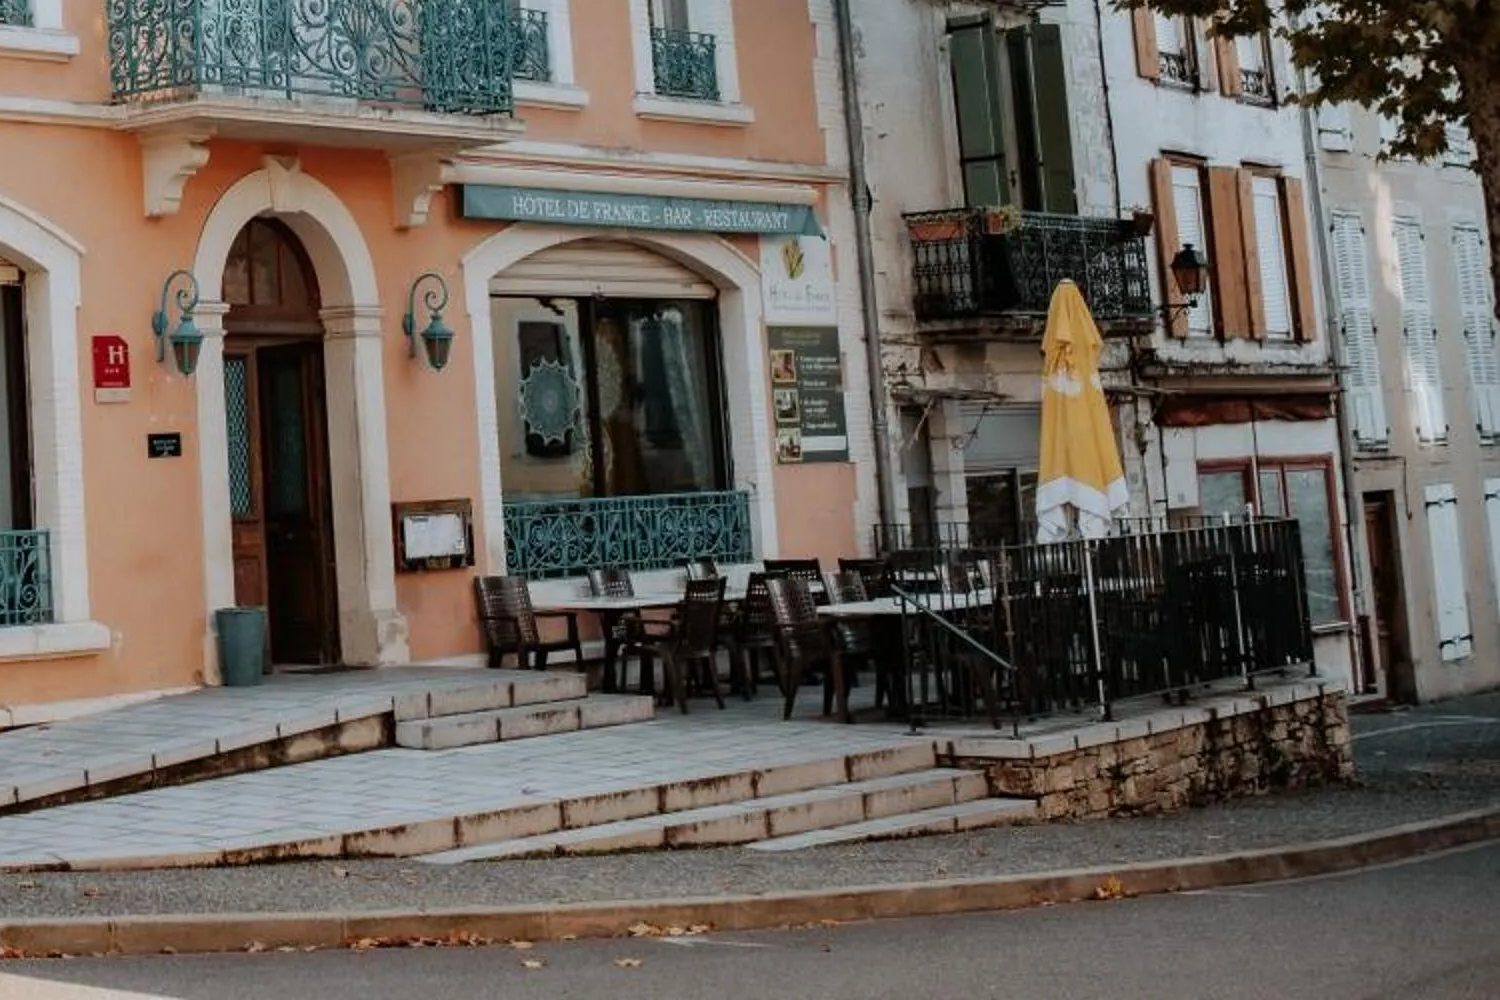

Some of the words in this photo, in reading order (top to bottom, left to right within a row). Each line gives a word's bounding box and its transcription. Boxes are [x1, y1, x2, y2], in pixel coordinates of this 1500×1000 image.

[567, 199, 590, 219] DE
[593, 201, 652, 223] FRANCE
[663, 206, 693, 225] BAR
[703, 208, 789, 230] RESTAURANT
[108, 345, 125, 365] H
